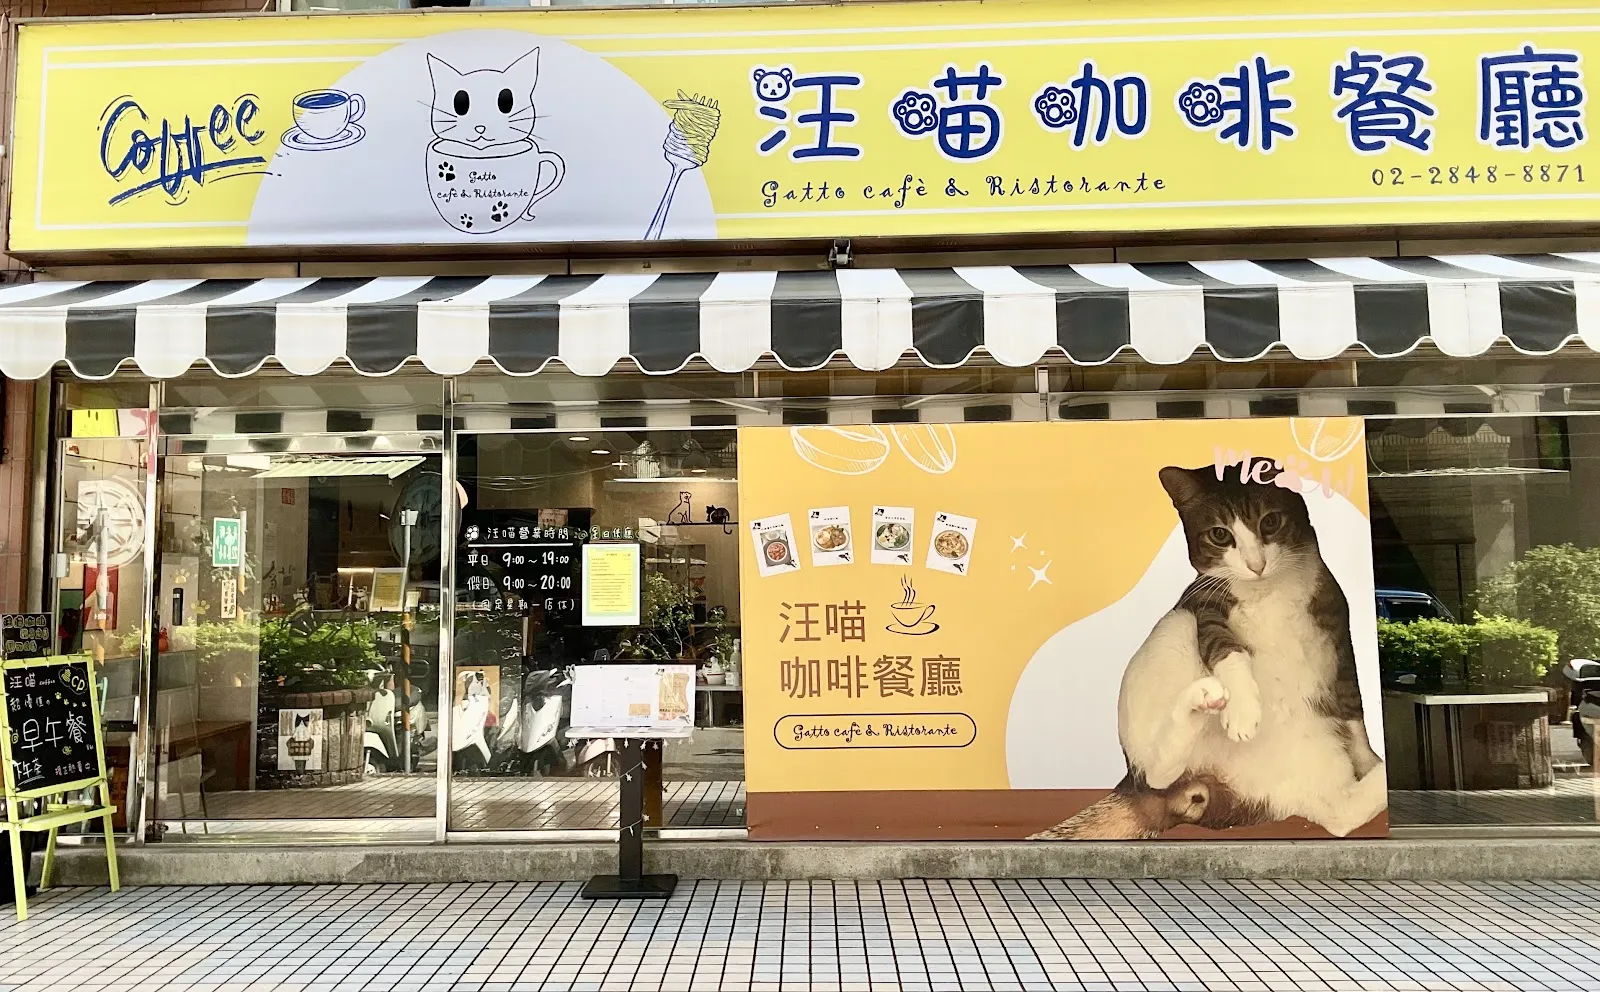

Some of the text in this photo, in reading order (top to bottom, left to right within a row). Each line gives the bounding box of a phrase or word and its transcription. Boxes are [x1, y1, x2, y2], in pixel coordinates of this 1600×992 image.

[752, 45, 1585, 160] 汪喵咖啡餐廳
[100, 98, 267, 200] Coffee
[469, 171, 497, 183] Gatto
[1371, 164, 1585, 186] 02-2848-8871
[460, 189, 471, 199] &
[473, 188, 529, 199] Ristorante
[761, 172, 1166, 208] Gatto cafè & Ristorante
[467, 554, 489, 566] 平日
[467, 576, 490, 590] 假日
[778, 600, 866, 643] 汪喵
[10, 672, 36, 688] 汪喵
[780, 654, 963, 699] 咖啡餐廳
[21, 711, 87, 752] 早午餐
[793, 724, 830, 741] Gatto
[865, 725, 880, 736] &
[883, 724, 958, 737] Ristorante
